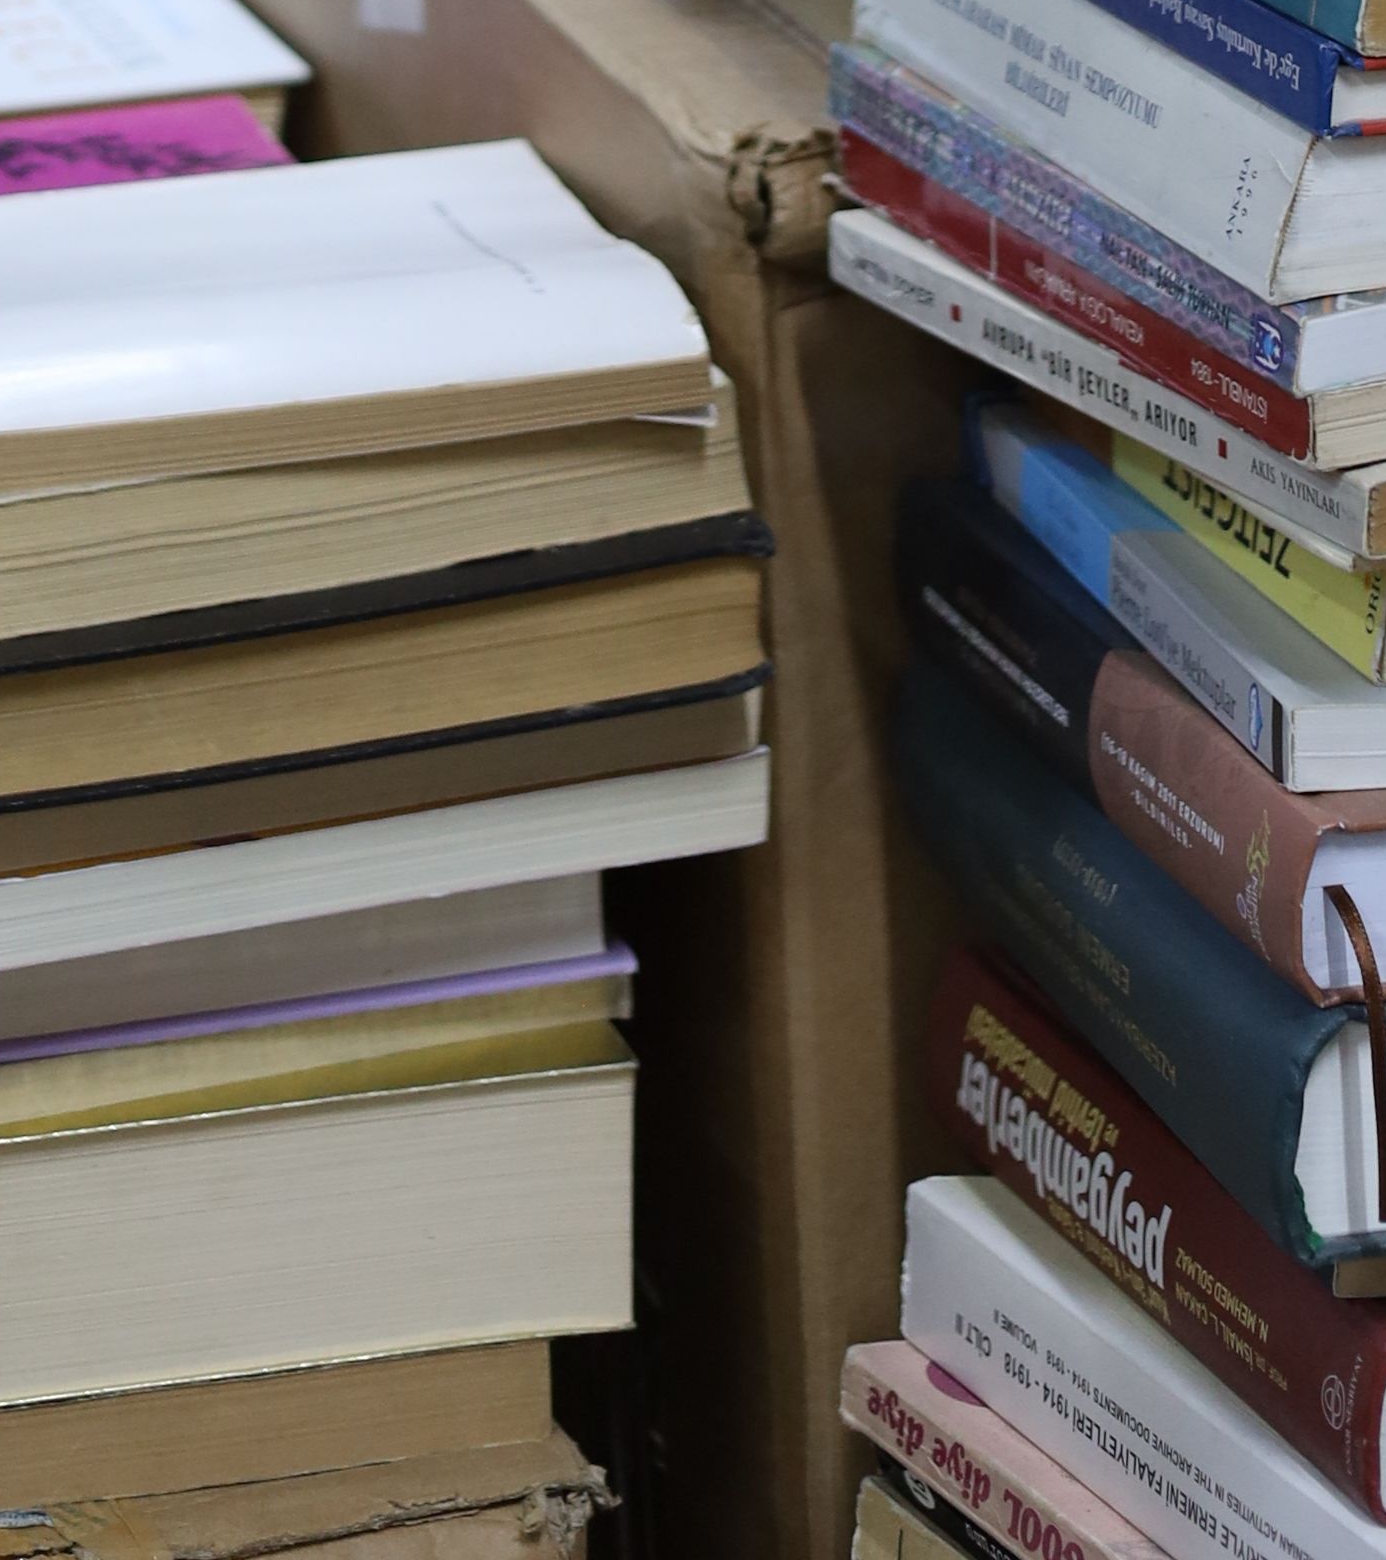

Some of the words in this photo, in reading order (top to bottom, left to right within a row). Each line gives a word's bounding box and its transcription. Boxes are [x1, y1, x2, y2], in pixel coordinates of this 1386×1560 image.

[1216, 18, 1263, 71] Kurtuluş
[1264, 48, 1302, 92] Ege'de
[1225, 158, 1251, 241] ANKARA
[981, 316, 1035, 367] AVRUPA
[1143, 399, 1199, 448] ARIYOR
[1249, 456, 1276, 484] AKİS
[1280, 469, 1341, 520] YAYINLARI
[957, 1051, 1173, 1291] peygamberler
[1175, 1247, 1215, 1299] SOLMAZ
[1213, 1280, 1257, 1331] MEHMED
[1256, 1317, 1269, 1344] N.
[966, 1321, 993, 1359] CİLT
[1000, 1311, 1039, 1355] VOLUME
[1219, 1320, 1255, 1372] İSMAİL
[1003, 1352, 1032, 1390] 1918
[1045, 1349, 1066, 1377] 1918
[1072, 1370, 1091, 1399] 1914
[866, 1386, 925, 1457] diye
[1042, 1379, 1071, 1422] 1914
[1093, 1385, 1151, 1448] DOCUMENTS
[931, 1437, 992, 1510] diye
[1071, 1405, 1164, 1497] FAALİYETLERİ
[1151, 1432, 1193, 1481] ARCHIVE
[1193, 1467, 1213, 1499] THE
[1213, 1483, 1225, 1505] IN
[1163, 1479, 1217, 1543] ERMENİ
[1226, 1493, 1279, 1545] ACTIVITIES
